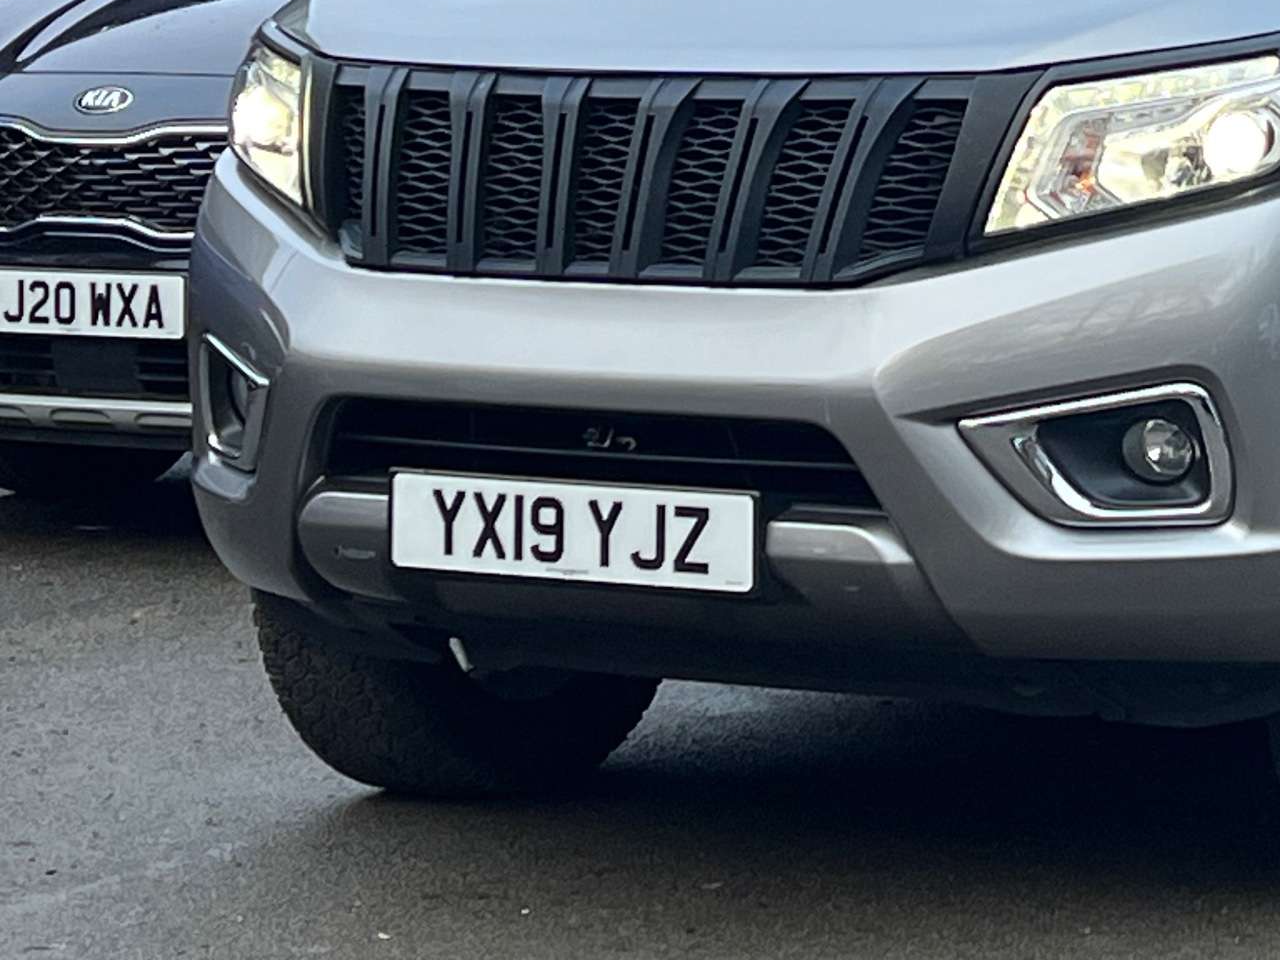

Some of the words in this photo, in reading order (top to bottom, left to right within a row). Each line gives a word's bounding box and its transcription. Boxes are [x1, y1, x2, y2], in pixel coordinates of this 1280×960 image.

[81, 89, 121, 108] KIA
[4, 279, 76, 325] J20
[90, 282, 164, 328] WXA
[432, 489, 565, 563] YX19
[588, 499, 710, 575] YJZ
